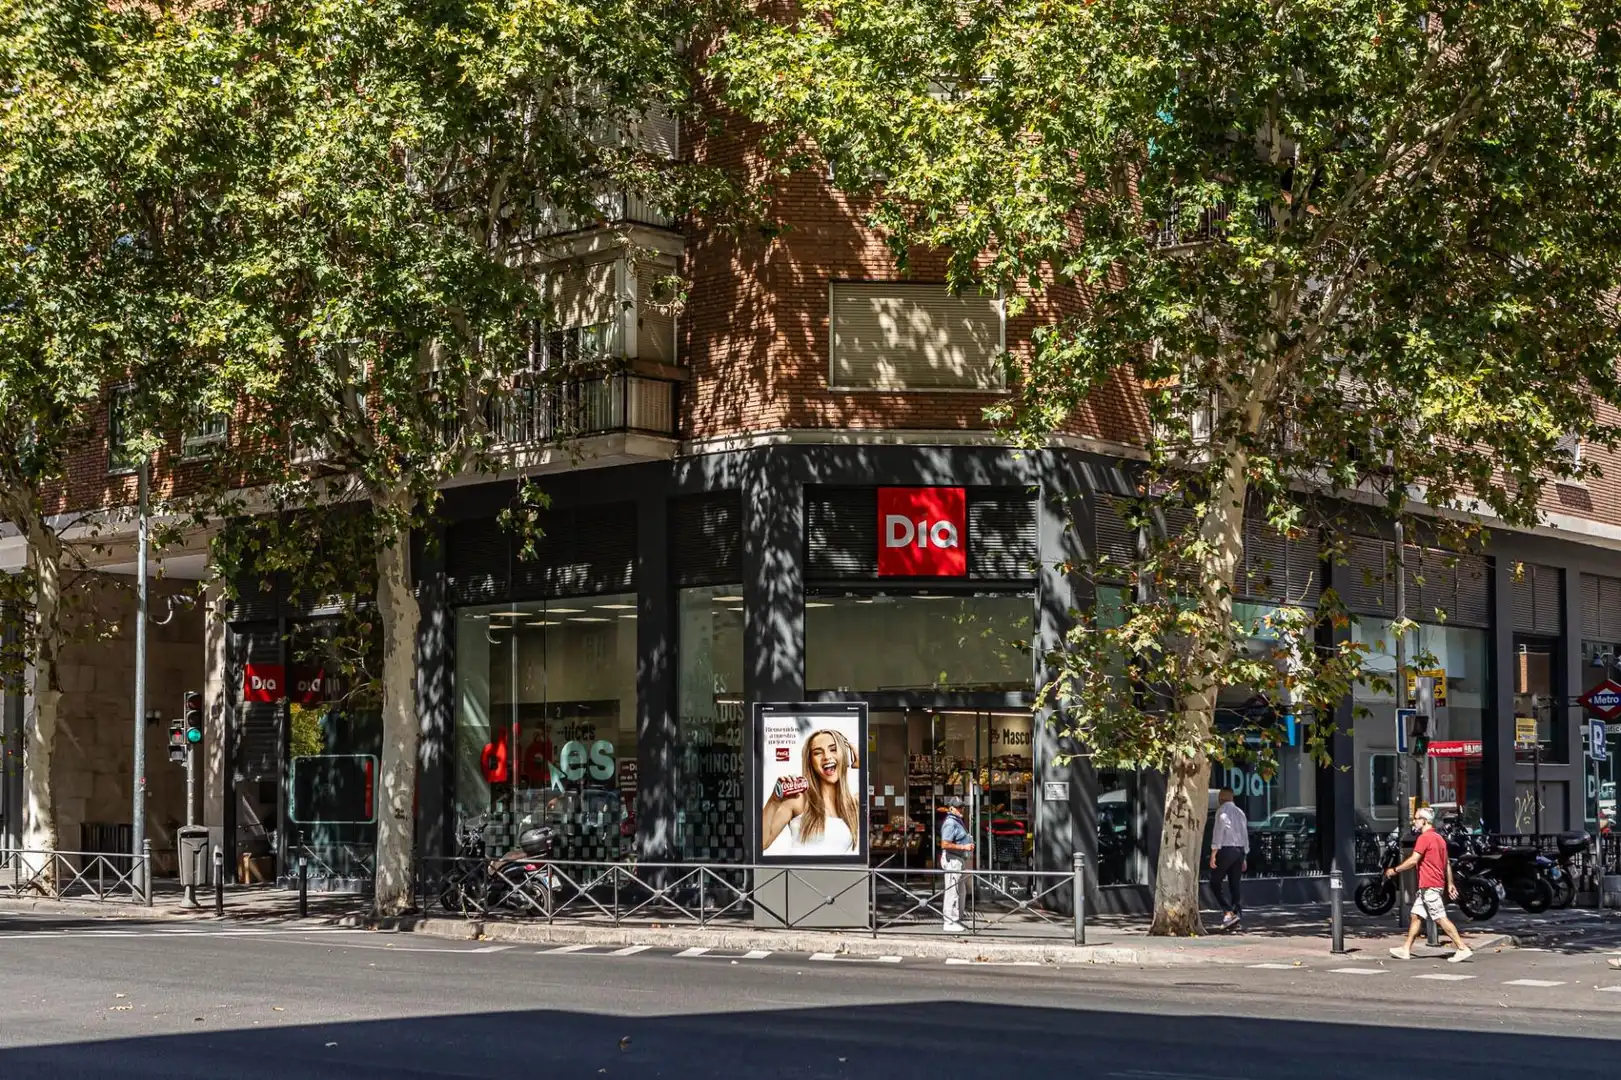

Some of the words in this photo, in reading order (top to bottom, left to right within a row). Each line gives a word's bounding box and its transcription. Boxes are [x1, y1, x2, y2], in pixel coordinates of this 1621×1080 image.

[886, 514, 958, 548] Dia
[251, 676, 277, 690] Dia
[1594, 696, 1619, 704] Metro
[1231, 767, 1264, 797] Dia
